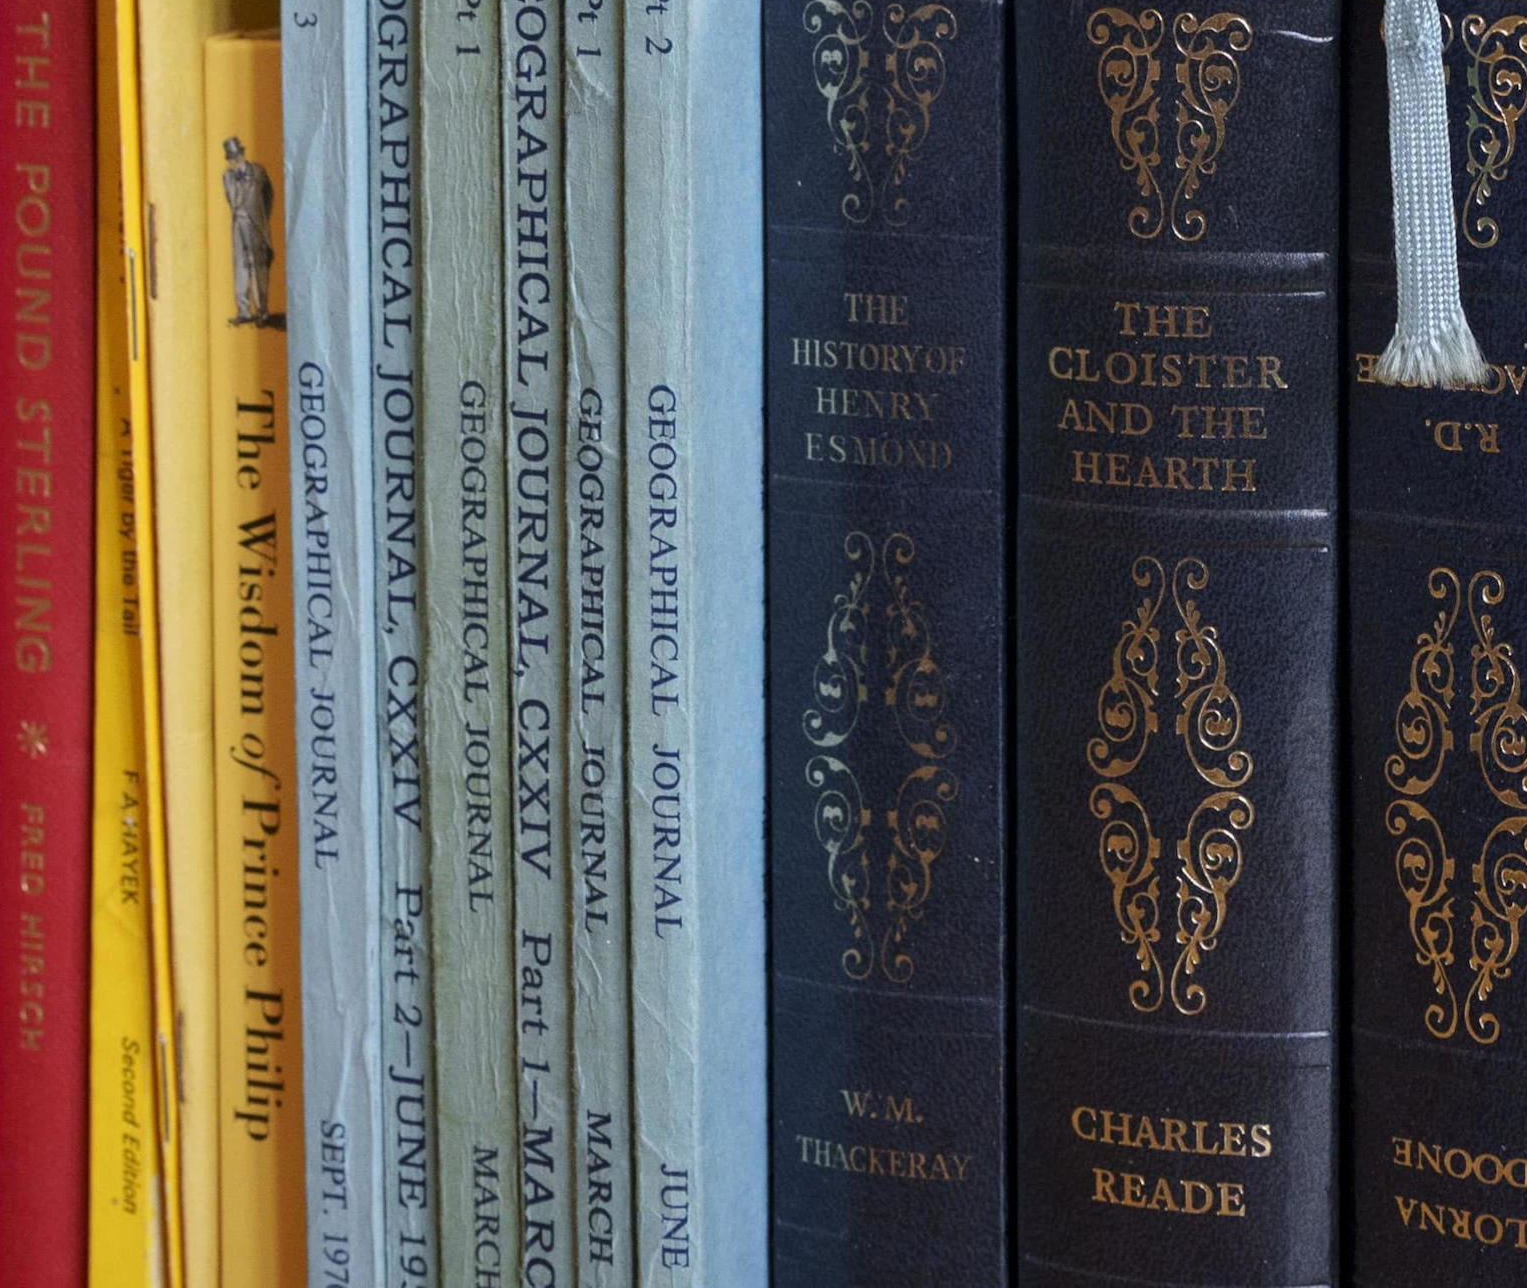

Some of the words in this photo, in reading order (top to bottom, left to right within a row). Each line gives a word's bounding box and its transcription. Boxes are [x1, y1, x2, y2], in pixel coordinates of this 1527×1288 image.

[15, 11, 51, 128] THE
[293, 12, 318, 29] 3
[456, 45, 481, 57] 1
[577, 45, 601, 58] 1
[644, 36, 673, 56] 2
[15, 162, 54, 372] POUND
[844, 291, 910, 326] THE
[791, 337, 925, 374] HISTORY
[925, 345, 969, 376] OF
[1047, 346, 1290, 390] CLOISTER
[1113, 300, 1213, 339] THE
[236, 389, 277, 491] The
[806, 432, 953, 470] ESMOND
[816, 386, 940, 422] HENRY
[1057, 399, 1154, 437] AND
[1170, 403, 1268, 441] THE
[297, 362, 334, 669] GEOGRAPHICAL
[376, 365, 417, 635] JOURNAL,
[1071, 450, 1258, 493] HEARTH
[14, 397, 54, 674] STERLING
[122, 550, 138, 587] the
[460, 380, 490, 703] GEOGRAPHICAL
[510, 401, 551, 678] JOURNAL,
[576, 387, 606, 714] GEOGRAPHICAL
[648, 384, 681, 717] GEOGRAPHICAL
[122, 596, 140, 637] Tail
[237, 510, 279, 717] Wisdom
[122, 769, 140, 785] F
[230, 733, 283, 791] of
[310, 687, 341, 870] JOURNAL
[386, 655, 423, 833] CXXIV
[518, 698, 552, 879] CXXIV
[18, 802, 47, 896] FRED
[122, 791, 140, 810] A
[465, 721, 494, 914] JOURNAL
[579, 740, 608, 934] JOURNAL
[651, 743, 683, 941] JOURNAL
[120, 820, 141, 905] HAYEK
[242, 795, 282, 967] Prince
[18, 911, 47, 1052] HIRSCH
[392, 881, 424, 986] Part
[520, 929, 552, 1036] Part
[121, 1036, 142, 1123] Second
[233, 987, 286, 1143] Philip
[121, 1133, 142, 1215] Edition
[320, 1120, 348, 1215] SEPT.
[795, 1134, 972, 1182] THACKERAY
[1071, 1105, 1274, 1159] CHARLES
[472, 1144, 501, 1288] MARCH
[586, 1109, 613, 1267] MARCH
[658, 1162, 690, 1270] JUNE
[1090, 1167, 1248, 1218] READE
